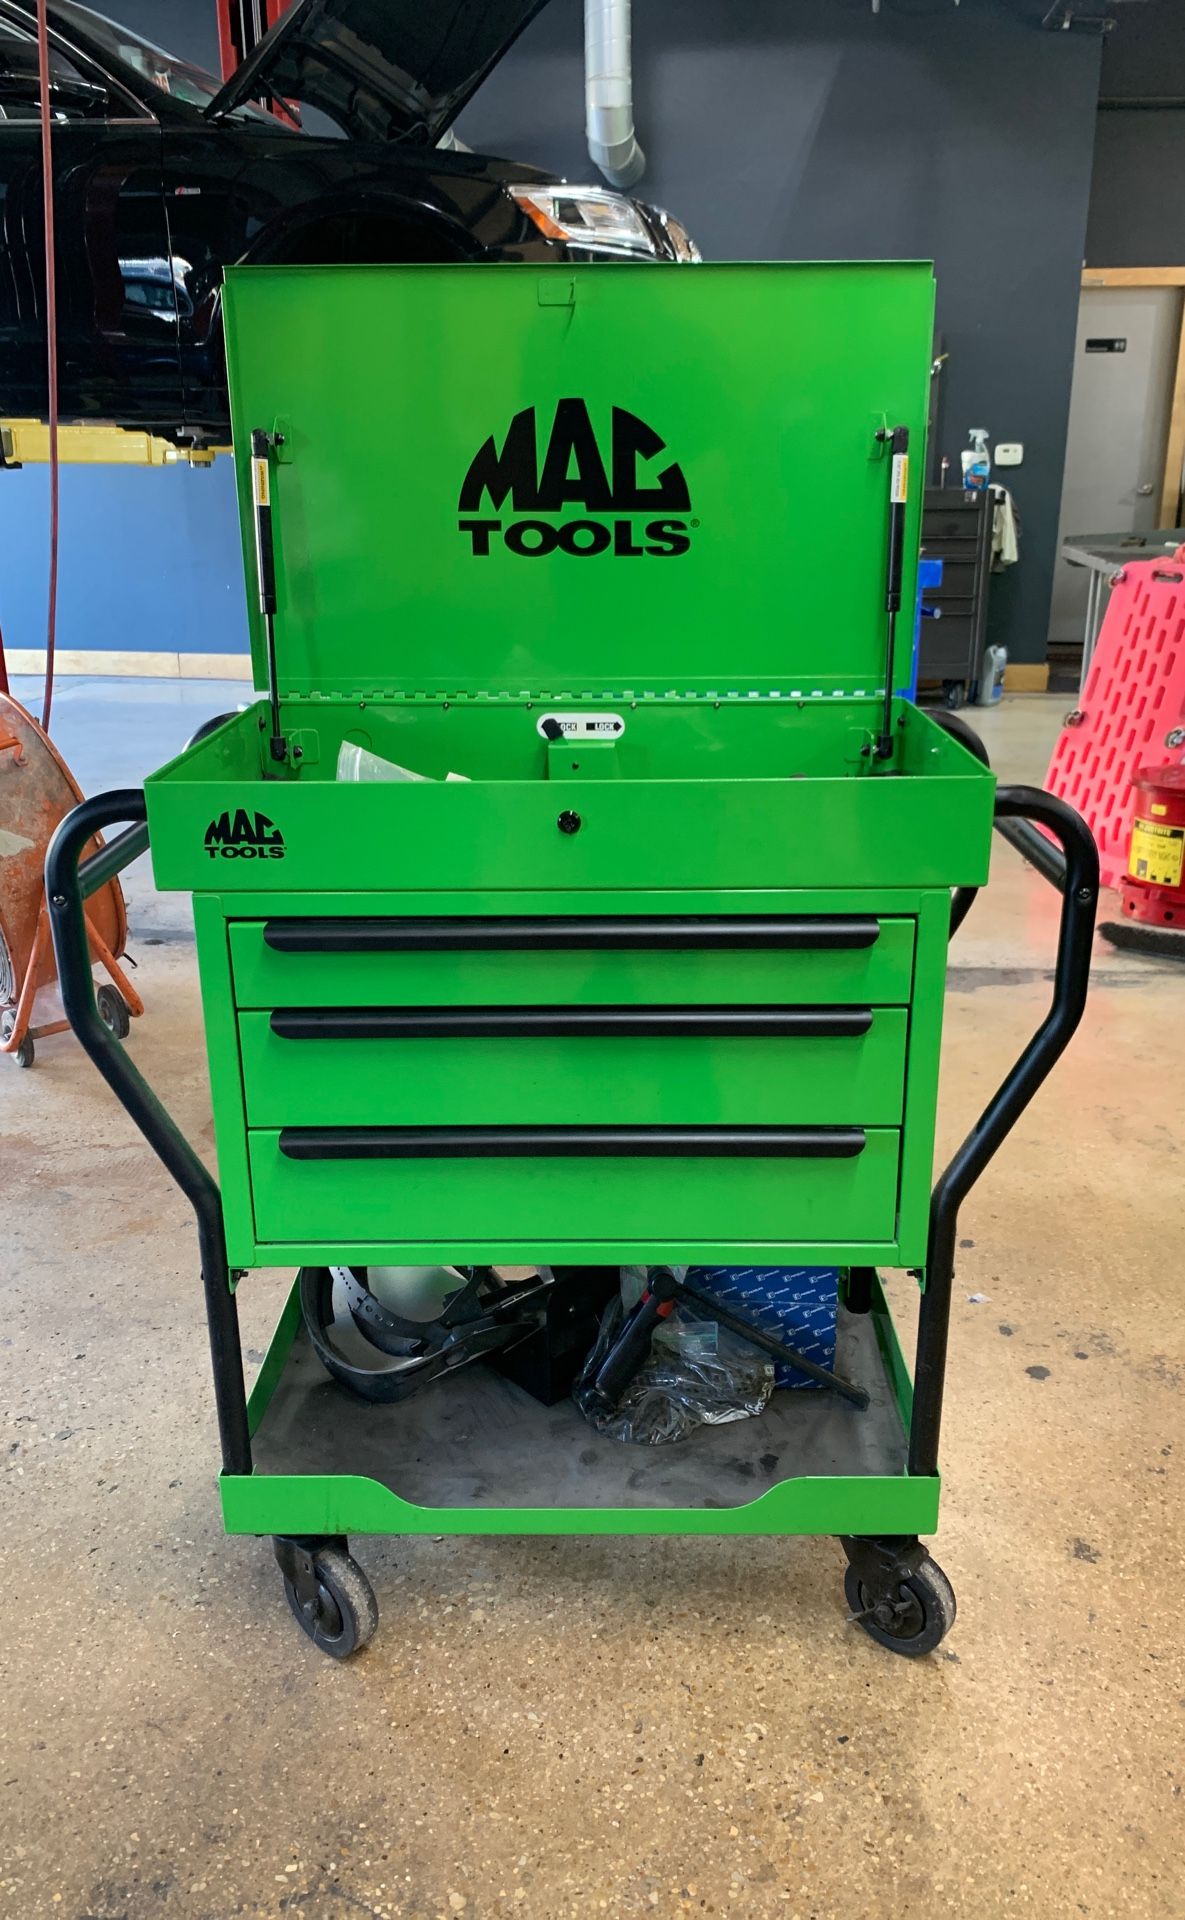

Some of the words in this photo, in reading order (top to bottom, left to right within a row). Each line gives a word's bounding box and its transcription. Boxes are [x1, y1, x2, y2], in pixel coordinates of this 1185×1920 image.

[457, 397, 692, 512] MAC
[595, 722, 614, 731] LOCK
[204, 808, 285, 845] MAC
